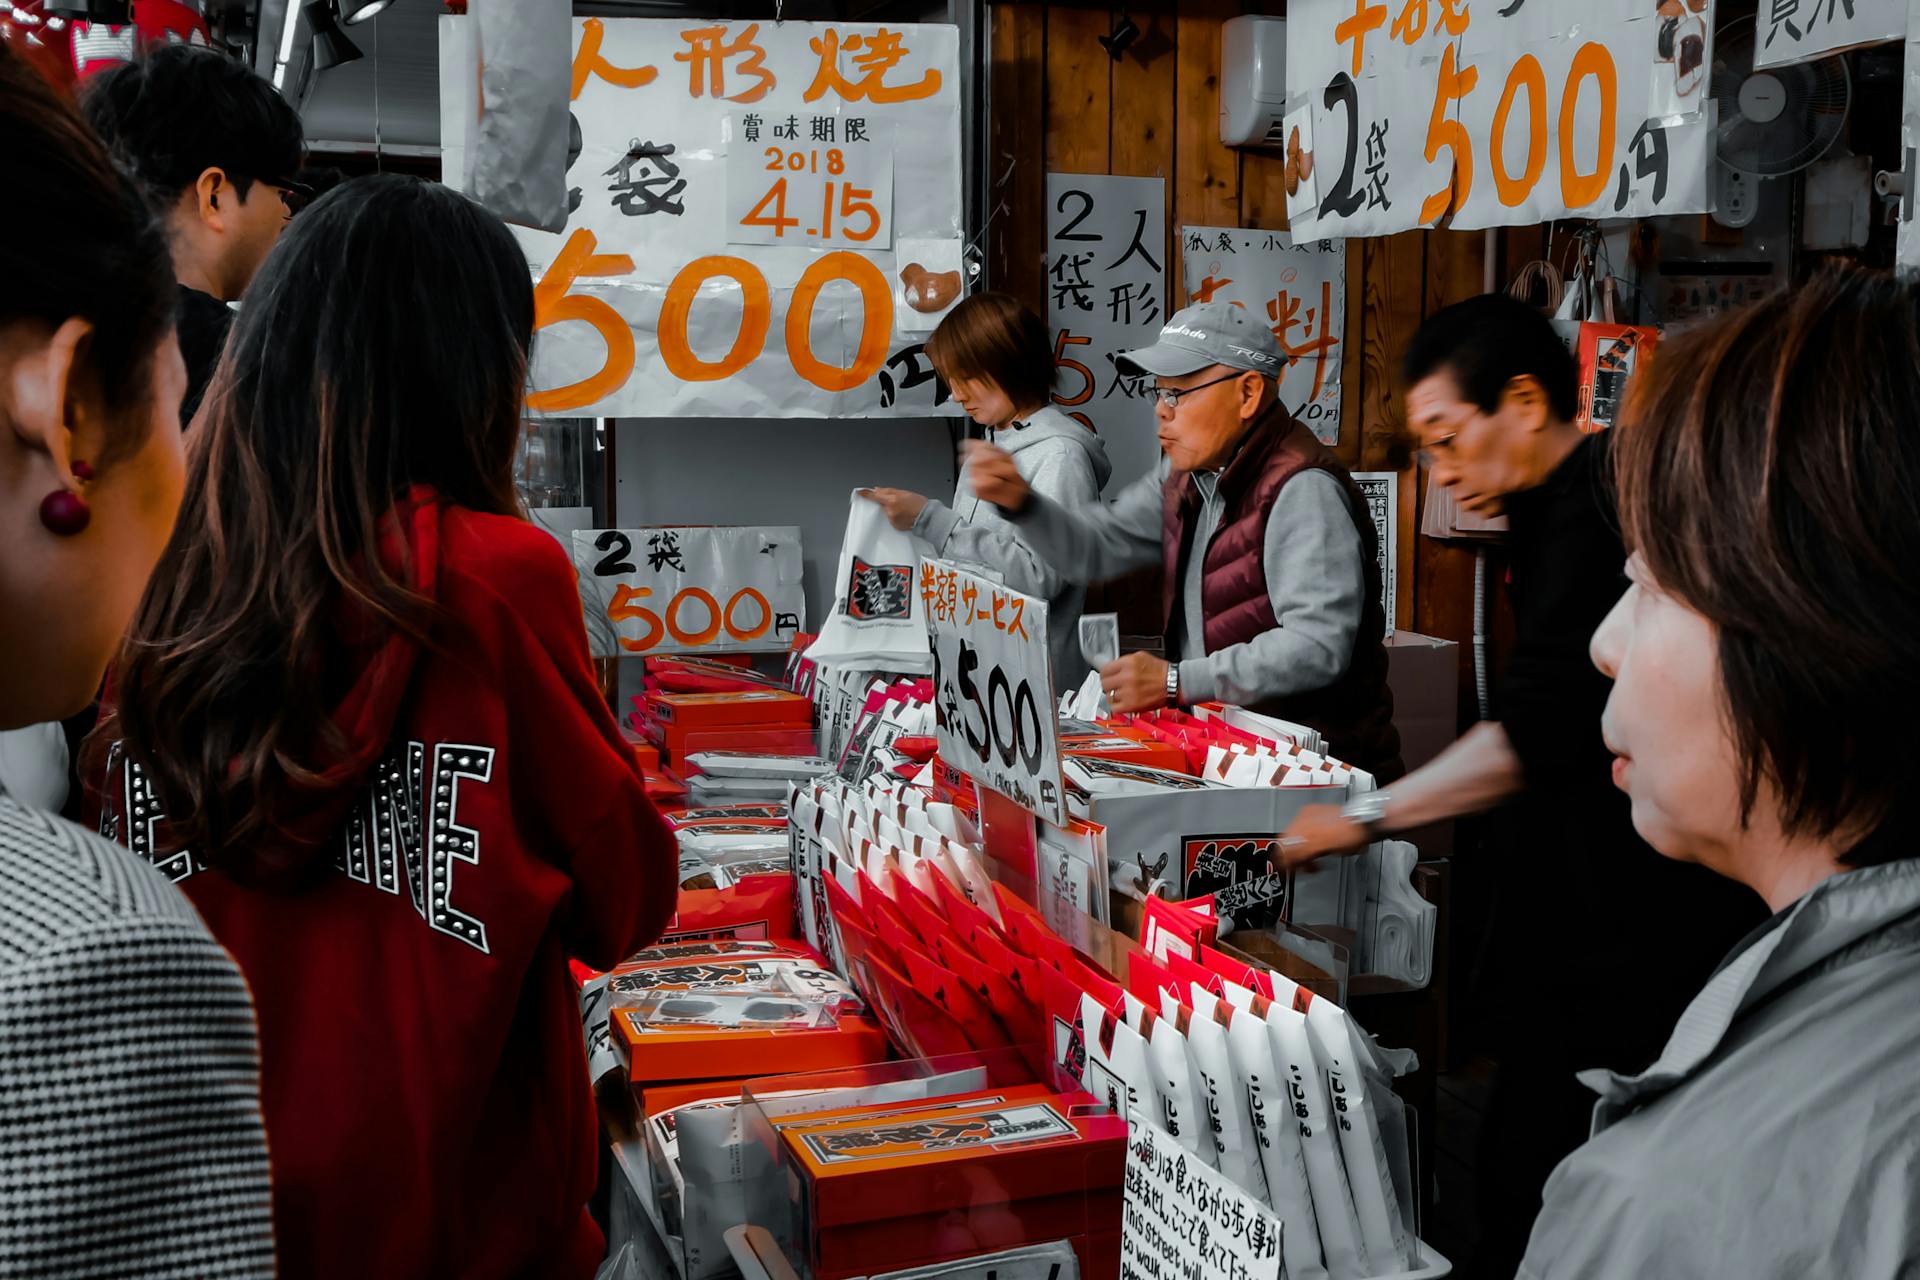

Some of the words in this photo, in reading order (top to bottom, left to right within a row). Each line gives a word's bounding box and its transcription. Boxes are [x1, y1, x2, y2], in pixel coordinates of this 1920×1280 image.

[743, 114, 871, 143] 賞味期限
[764, 147, 846, 176] 2018
[1317, 71, 1392, 220] 2袋
[1418, 42, 1669, 227] 500円
[740, 177, 881, 241] 4.15
[594, 531, 686, 577] 2袋
[607, 583, 800, 652] 500円
[920, 561, 1030, 642] 半額サービス
[1250, 1074, 1270, 1149] こしあん
[1290, 1064, 1312, 1138] こしあん
[1122, 1232, 1134, 1255] to
[1136, 1244, 1160, 1280] walk
[1123, 1197, 1144, 1237] This
[1145, 1222, 1180, 1269] street
